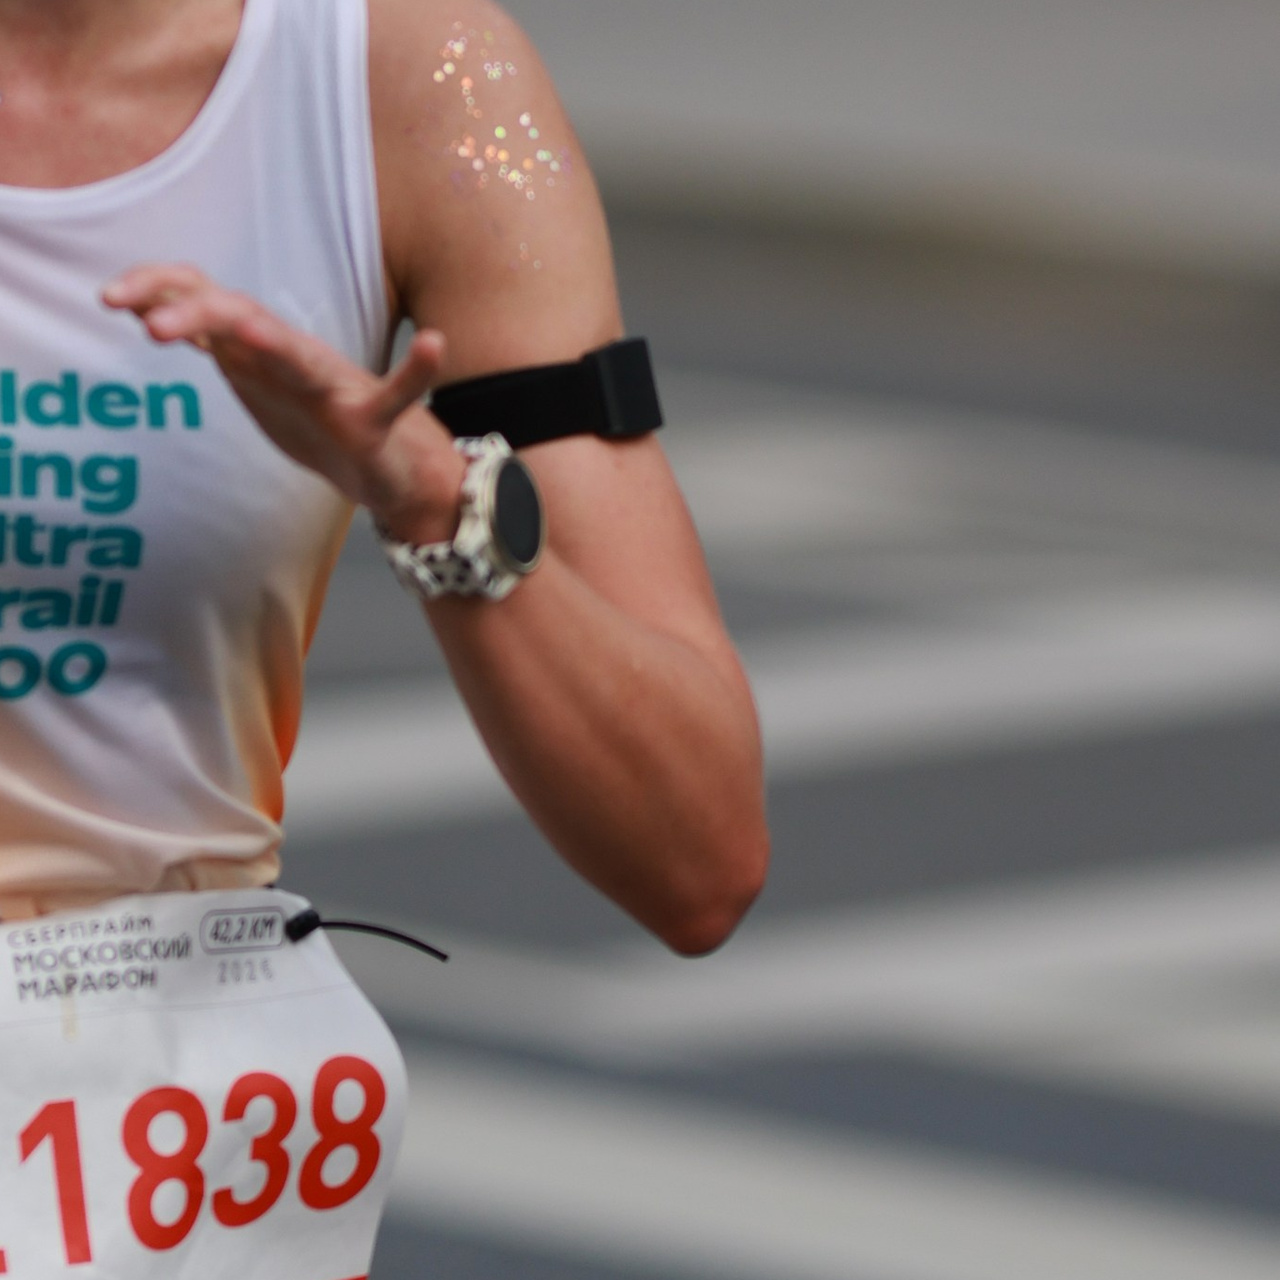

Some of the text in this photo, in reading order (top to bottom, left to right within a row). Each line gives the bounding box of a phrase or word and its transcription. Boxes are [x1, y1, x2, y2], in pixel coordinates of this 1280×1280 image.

[7, 913, 153, 948] СБЕРПРАЙМ
[210, 917, 248, 944] 42,2
[13, 932, 192, 974] МОСКОВСКИЙ
[18, 966, 158, 1001] МАРАФОН
